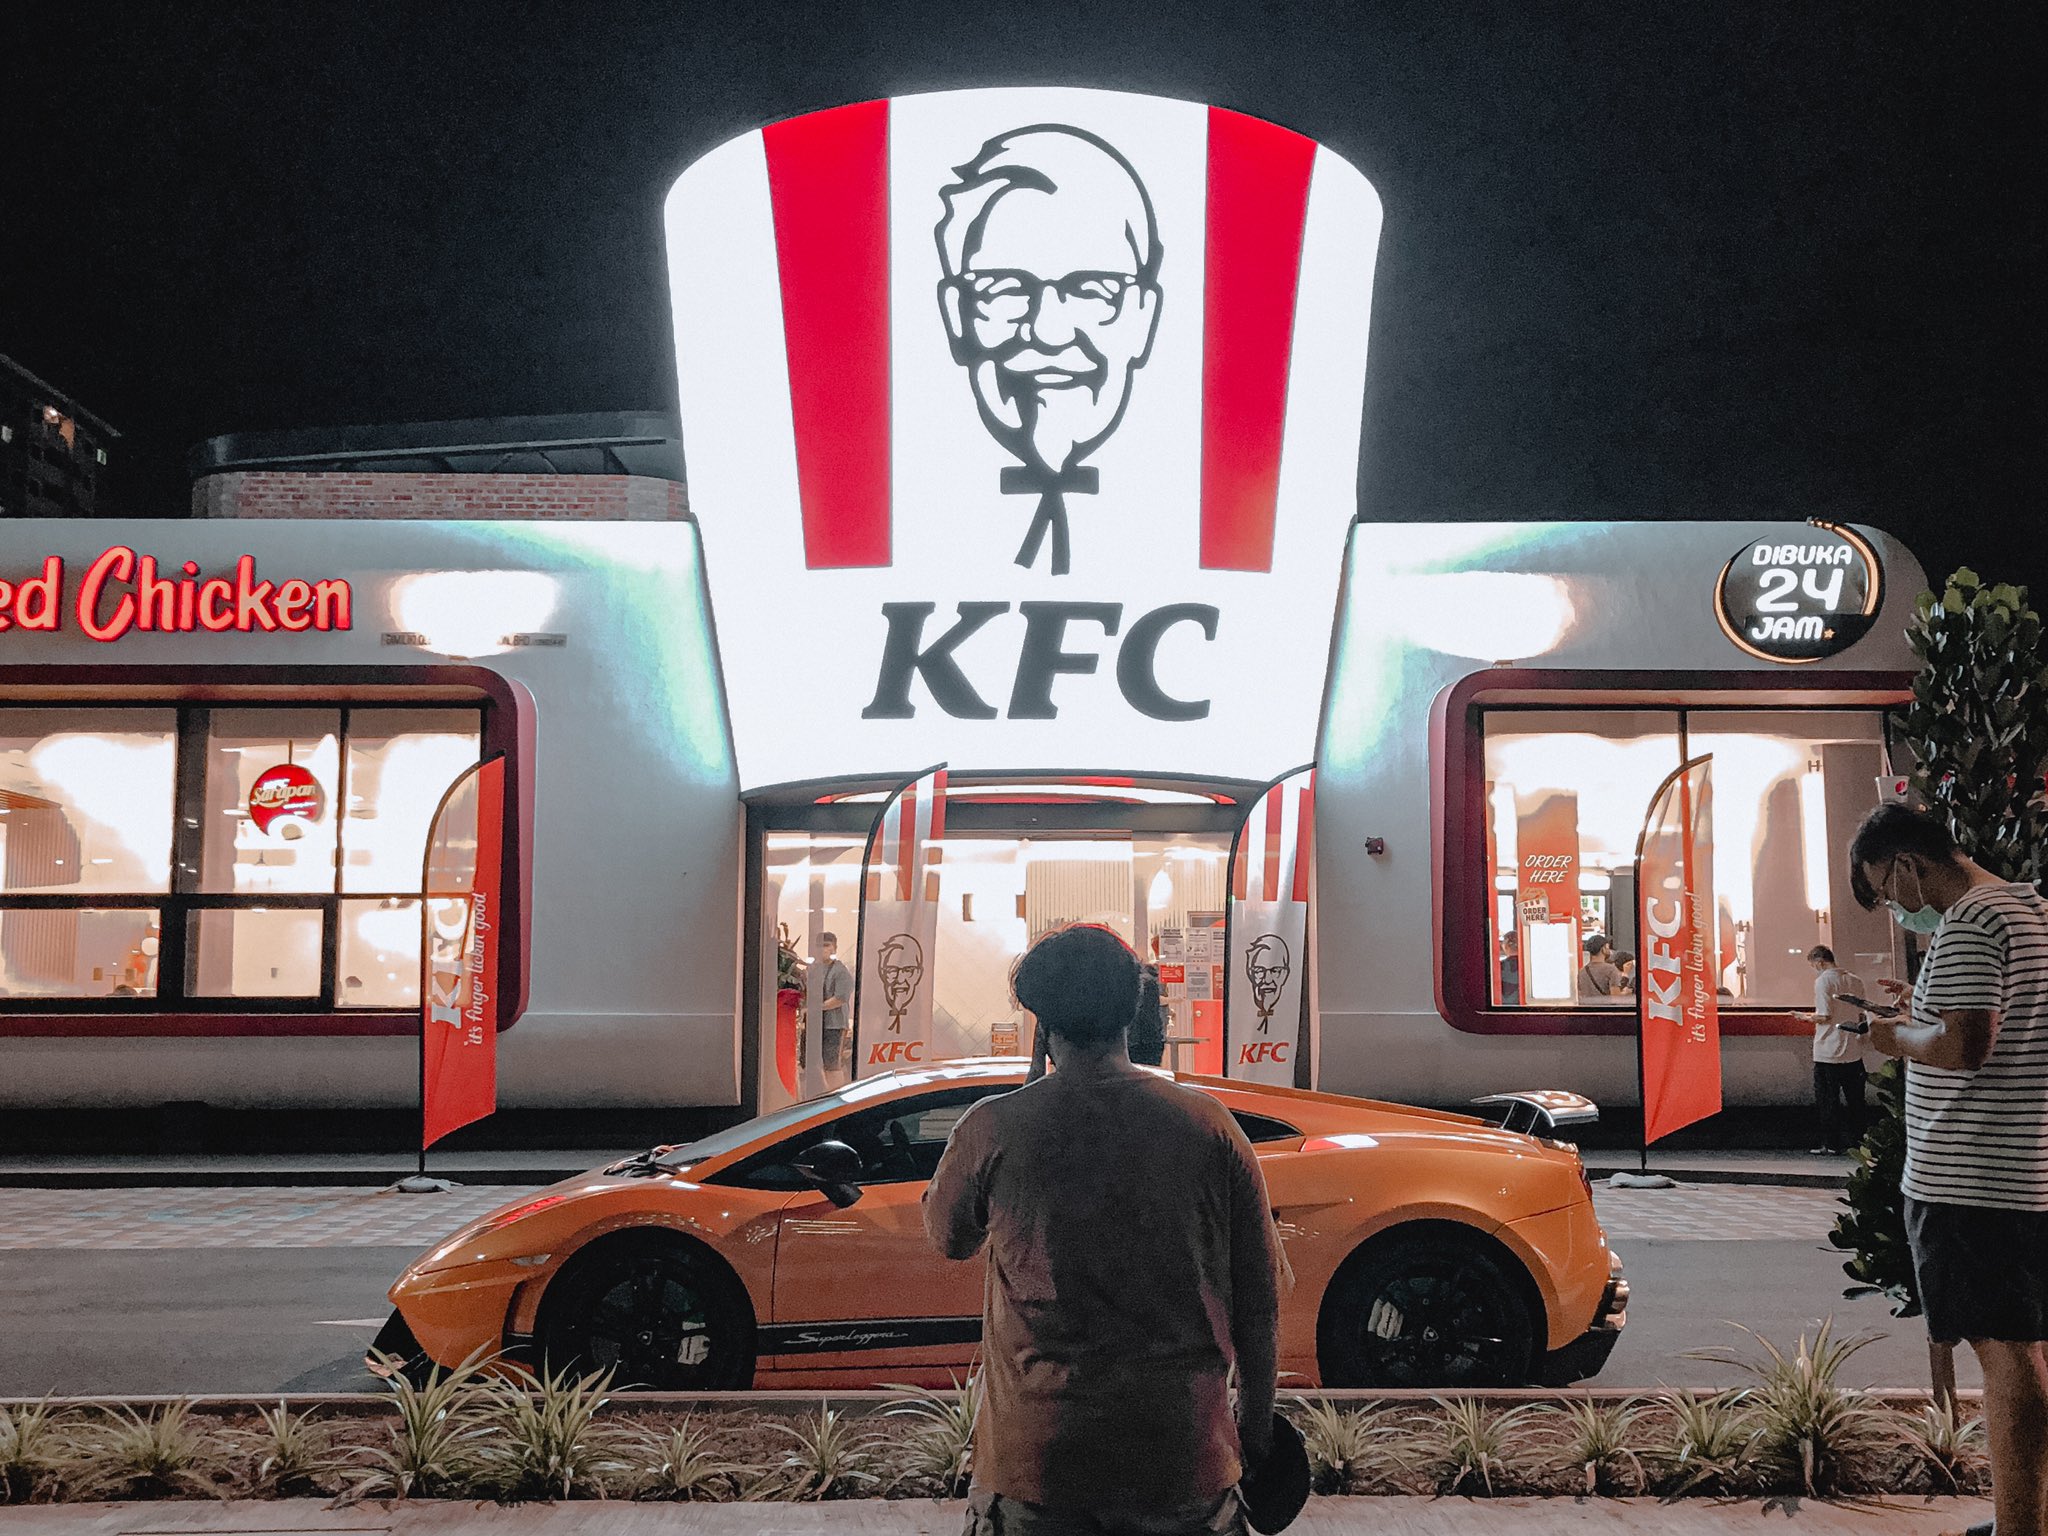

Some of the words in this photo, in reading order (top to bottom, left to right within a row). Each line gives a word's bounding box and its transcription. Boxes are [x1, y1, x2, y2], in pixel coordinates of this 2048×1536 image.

[1752, 544, 1853, 566] DIBUKA
[76, 545, 353, 643] Chicken
[1755, 568, 1845, 612] 24
[1751, 616, 1825, 640] JAM
[861, 601, 1221, 722] KFC
[1525, 854, 1573, 869] ORDER
[1529, 870, 1568, 883] HERE
[431, 898, 468, 1029] KFC
[1646, 896, 1684, 1027] KFC
[465, 976, 489, 1022] finger
[1687, 974, 1711, 1019] finger
[867, 1041, 924, 1065] KFC
[1238, 1042, 1290, 1065] KFC
